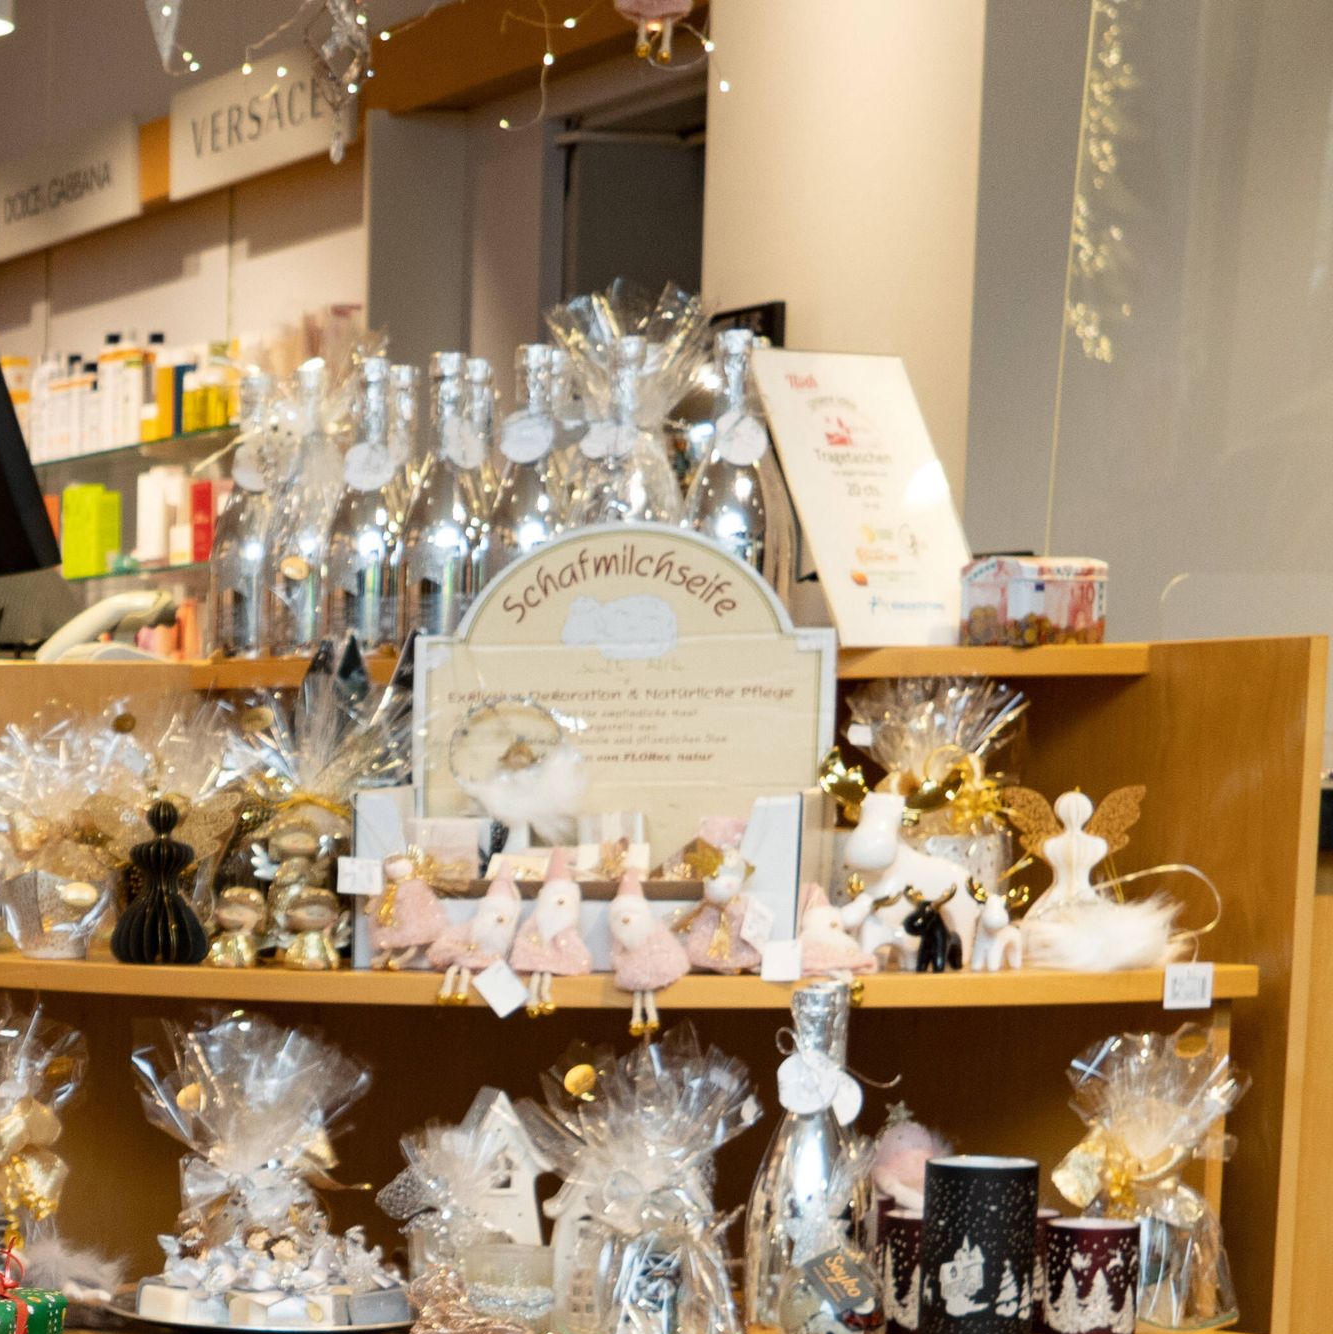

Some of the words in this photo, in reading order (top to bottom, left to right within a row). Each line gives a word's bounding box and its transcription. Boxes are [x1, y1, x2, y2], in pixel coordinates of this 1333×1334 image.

[191, 78, 325, 159] VERSACE
[502, 544, 738, 624] Schafmilchseife
[741, 685, 795, 702] Pflege
